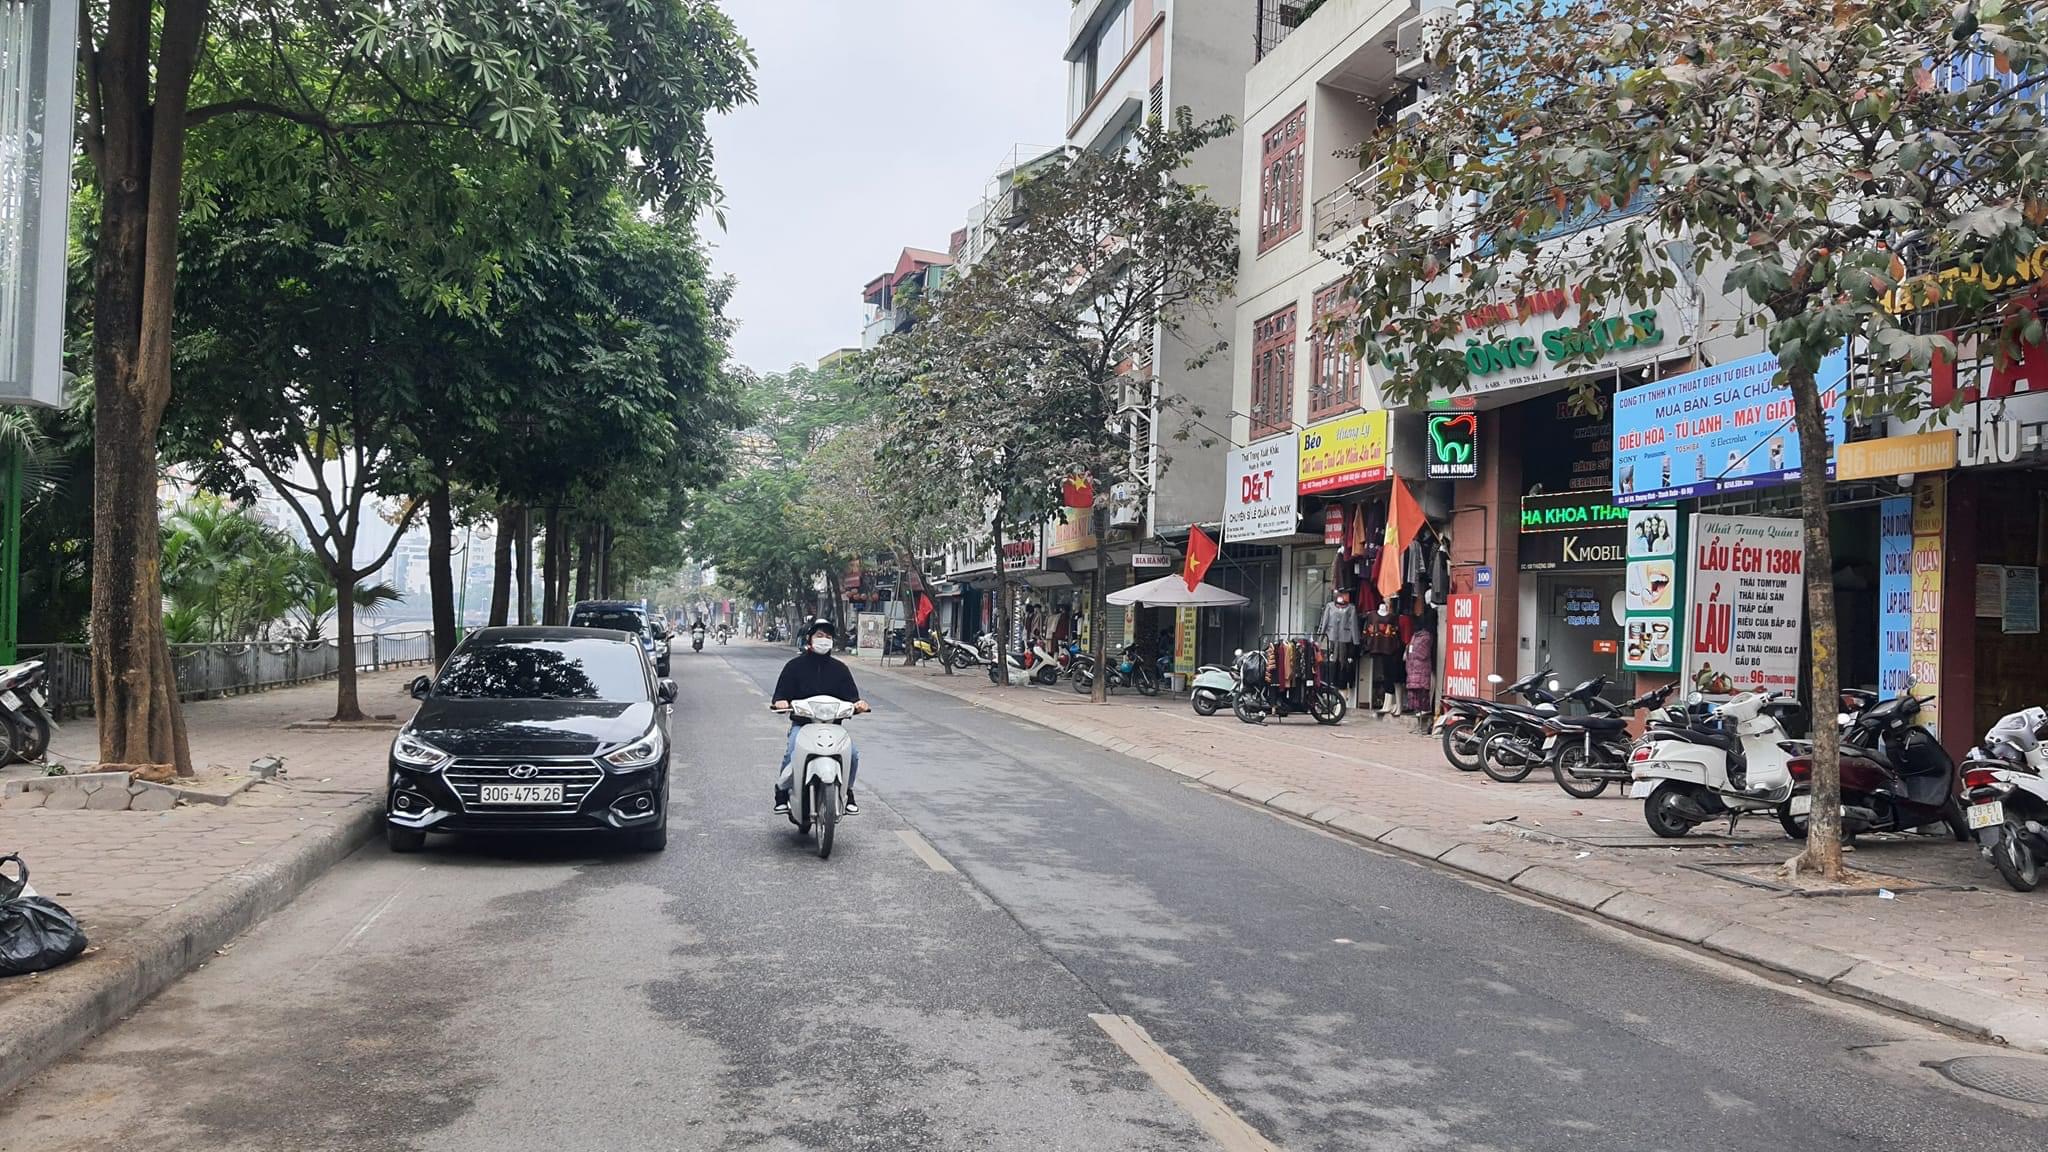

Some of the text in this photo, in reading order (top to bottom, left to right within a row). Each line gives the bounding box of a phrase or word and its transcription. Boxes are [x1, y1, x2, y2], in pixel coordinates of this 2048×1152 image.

[1639, 394, 1646, 404] TY
[1648, 388, 1665, 400] TNHH
[1679, 378, 1701, 393] THUẬT
[1656, 403, 1680, 419] MUA
[1714, 387, 1741, 406] SỬA
[1618, 428, 1641, 451] ĐIỀU
[1675, 417, 1689, 439] TỦ
[1692, 415, 1722, 438] LẠNH
[1735, 405, 1762, 427] MÁY
[1766, 397, 1796, 422] GIẶT
[1304, 432, 1322, 451] Béo
[1618, 455, 1638, 465] SONY
[1675, 443, 1700, 453] TOSHIBA
[1717, 434, 1748, 447] Electrolux
[1431, 463, 1474, 474] NHA KHOA
[1842, 446, 1866, 477] 96
[1871, 445, 1916, 472] THƯỢNG
[1242, 470, 1274, 504] D&T
[1545, 506, 1588, 523] KHOA
[1734, 523, 1765, 538] Trung
[1768, 525, 1792, 538] Quán
[1562, 535, 1625, 562] KMOBIL
[1700, 535, 1802, 574] LẨU ẾCH 138K
[1898, 548, 1912, 576] CHỮ
[1477, 572, 1490, 582] 100
[1740, 577, 1787, 588] THÁI TOMYUM
[1739, 590, 1754, 600] THÁI
[1454, 599, 1472, 618] CHO
[1695, 582, 1731, 654] LẨU
[1452, 620, 1473, 644] THUÊ
[1755, 617, 1769, 627] CUA
[1453, 647, 1471, 670] VĂN
[1764, 645, 1782, 654] CHUA
[1784, 646, 1798, 654] CAY
[1447, 671, 1476, 698] PHÒNG
[1750, 670, 1764, 684] 96
[1897, 670, 1909, 691] QU
[483, 787, 561, 801] 30G-475.26
